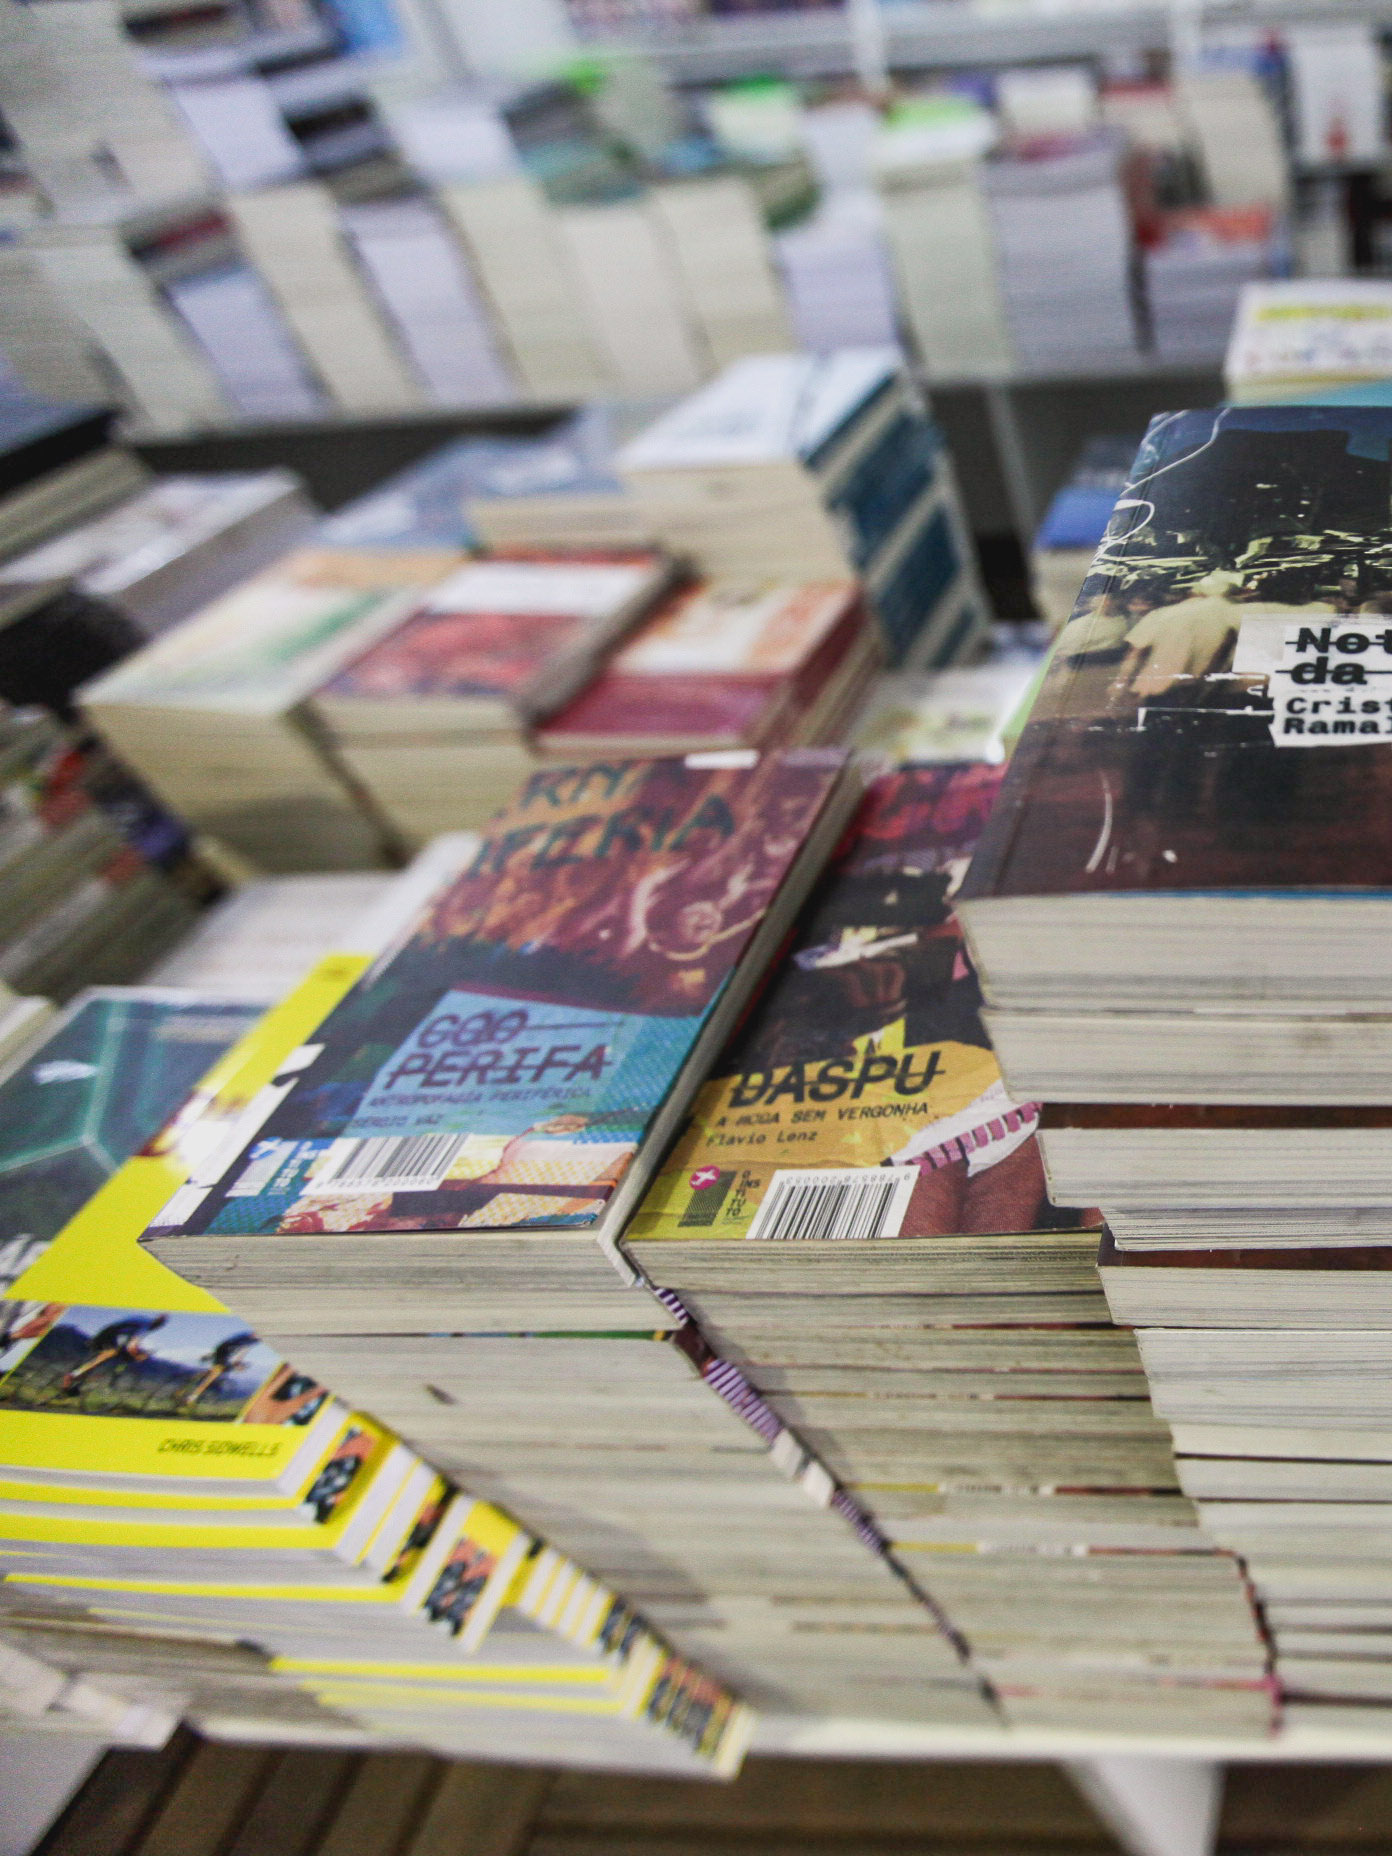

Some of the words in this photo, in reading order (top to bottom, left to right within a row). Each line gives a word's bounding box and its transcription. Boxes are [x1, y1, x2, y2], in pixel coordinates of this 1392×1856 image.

[1289, 656, 1369, 686] da
[384, 1043, 610, 1091] PERIFA
[727, 1050, 943, 1109] DASPU
[791, 1110, 826, 1124] SEM
[838, 1102, 929, 1120] VERGONHA
[776, 1130, 818, 1143] Lenz
